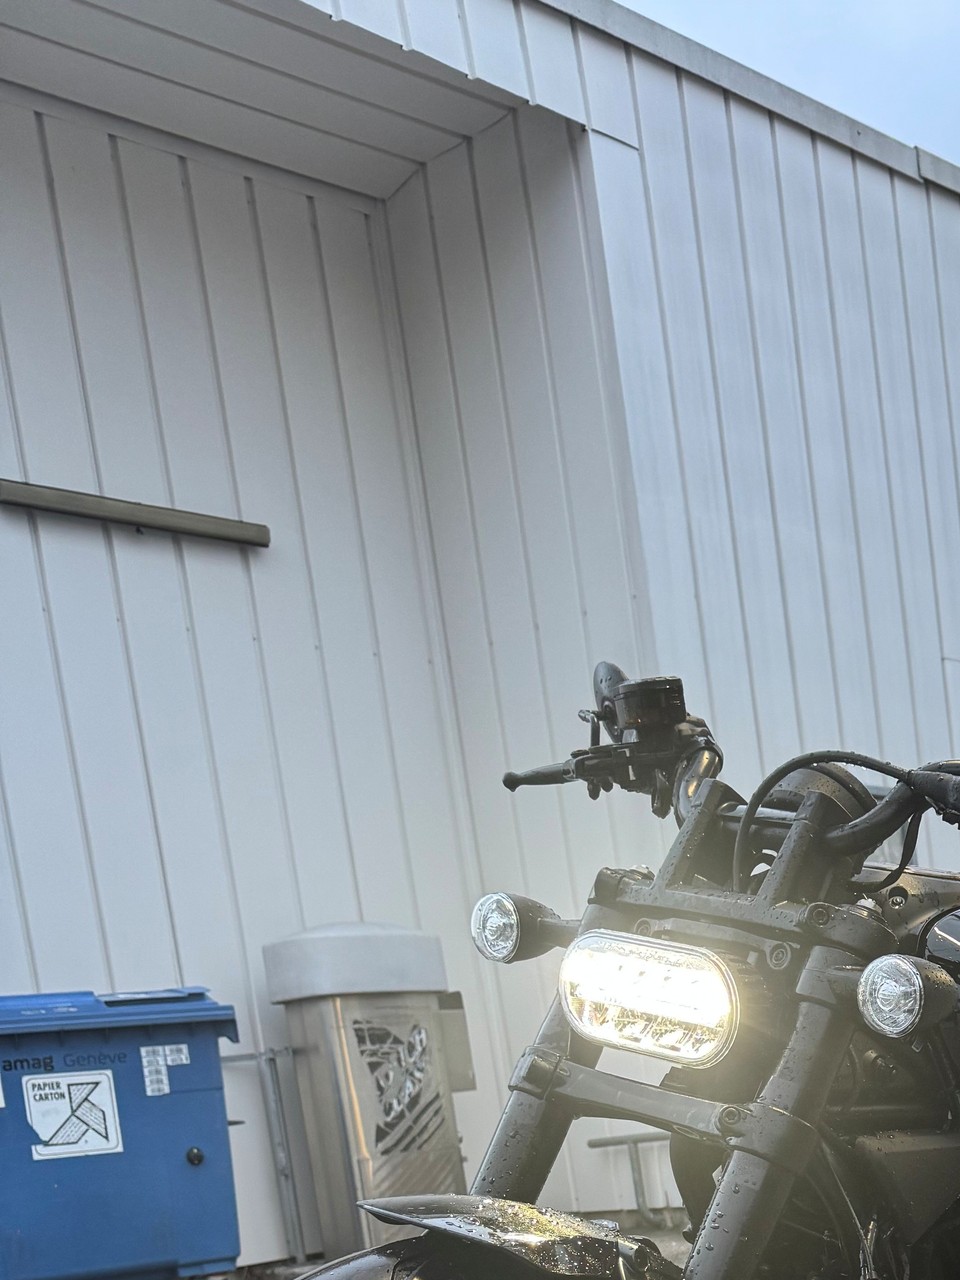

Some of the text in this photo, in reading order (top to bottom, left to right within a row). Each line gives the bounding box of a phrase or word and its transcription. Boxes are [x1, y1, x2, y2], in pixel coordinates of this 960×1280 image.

[2, 1051, 127, 1072] amag Genève
[31, 1081, 62, 1092] PAPIER
[33, 1091, 66, 1102] CARTON
